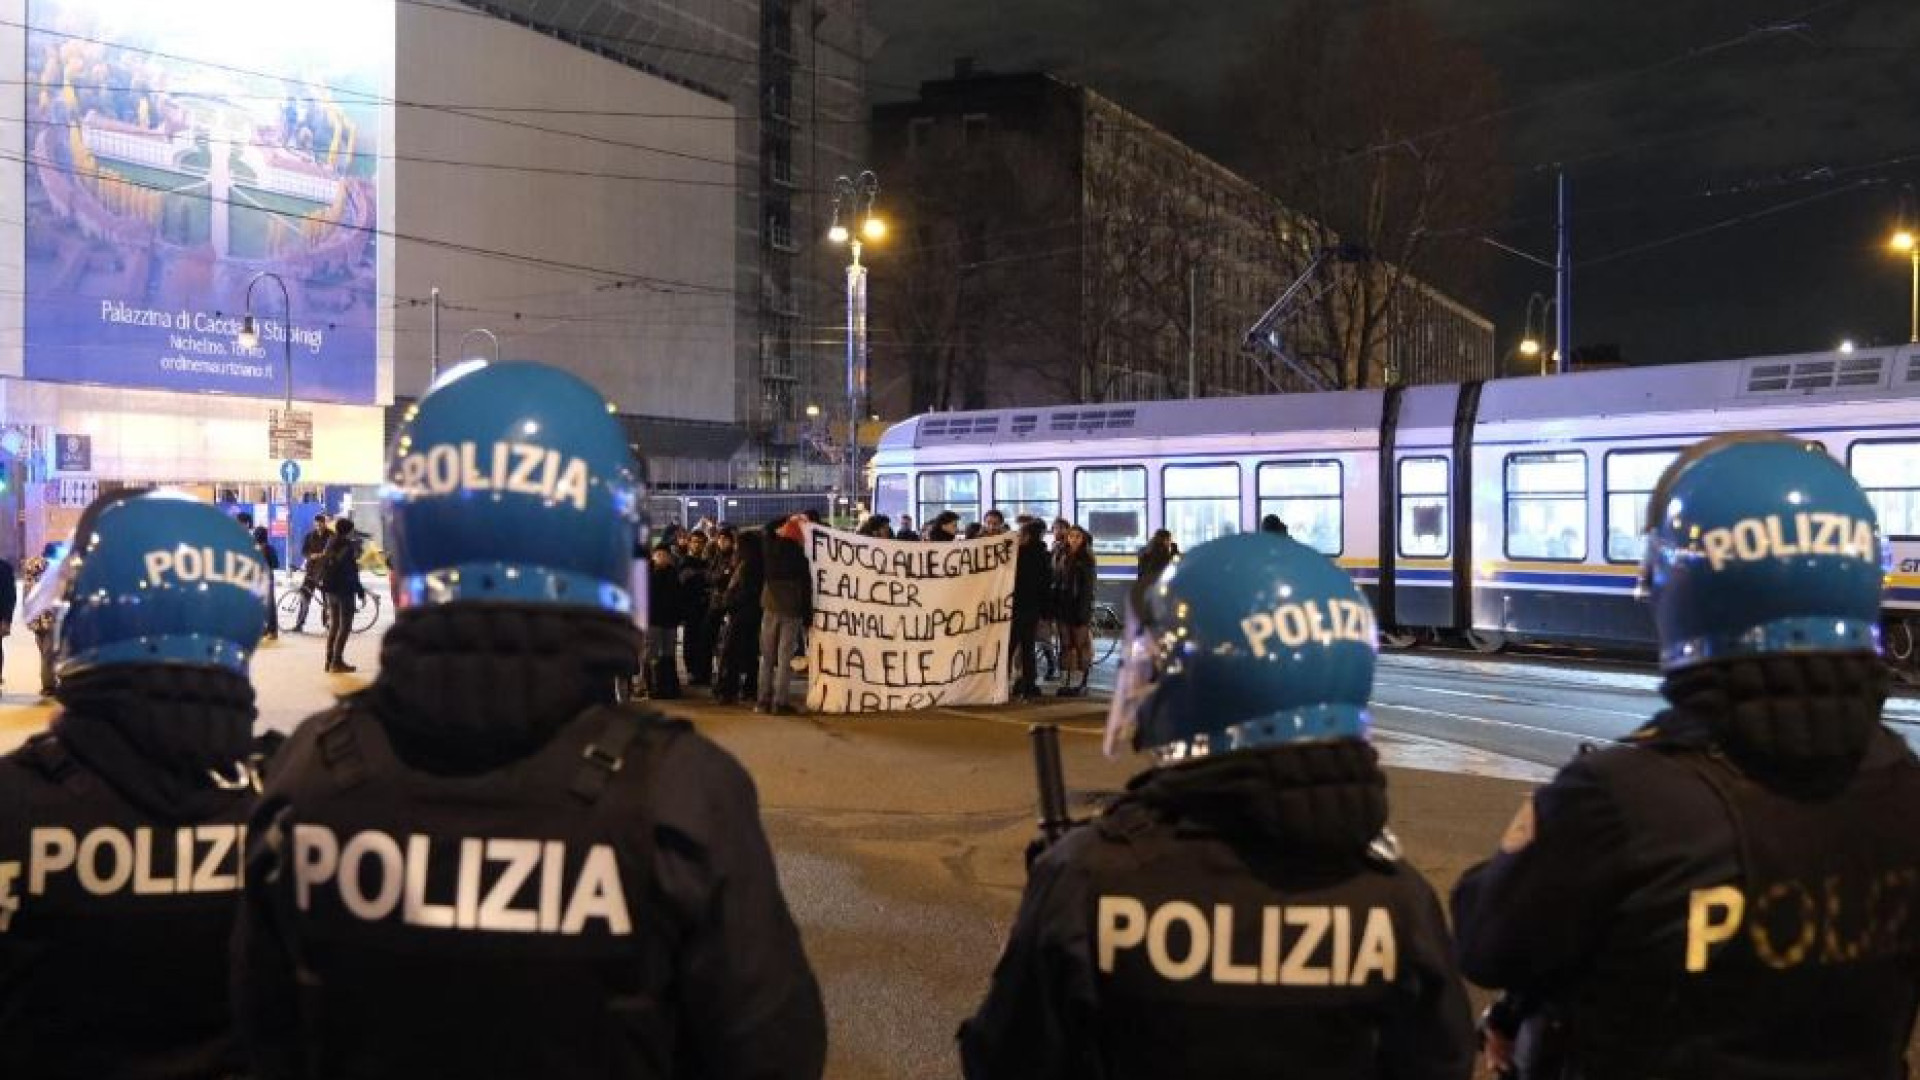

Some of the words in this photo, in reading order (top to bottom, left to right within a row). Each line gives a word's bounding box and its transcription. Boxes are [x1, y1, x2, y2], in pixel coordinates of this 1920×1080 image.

[102, 300, 171, 328] Palazzina
[176, 310, 190, 330] di
[400, 441, 588, 510] POLIZIA
[812, 530, 887, 575] FUOCO
[892, 549, 939, 579] ALLE
[1703, 512, 1874, 571] POLIZIA
[816, 569, 829, 597] E
[870, 580, 923, 608] CPR
[293, 823, 632, 935] POLIZIA
[1097, 896, 1397, 986] POLIZIA
